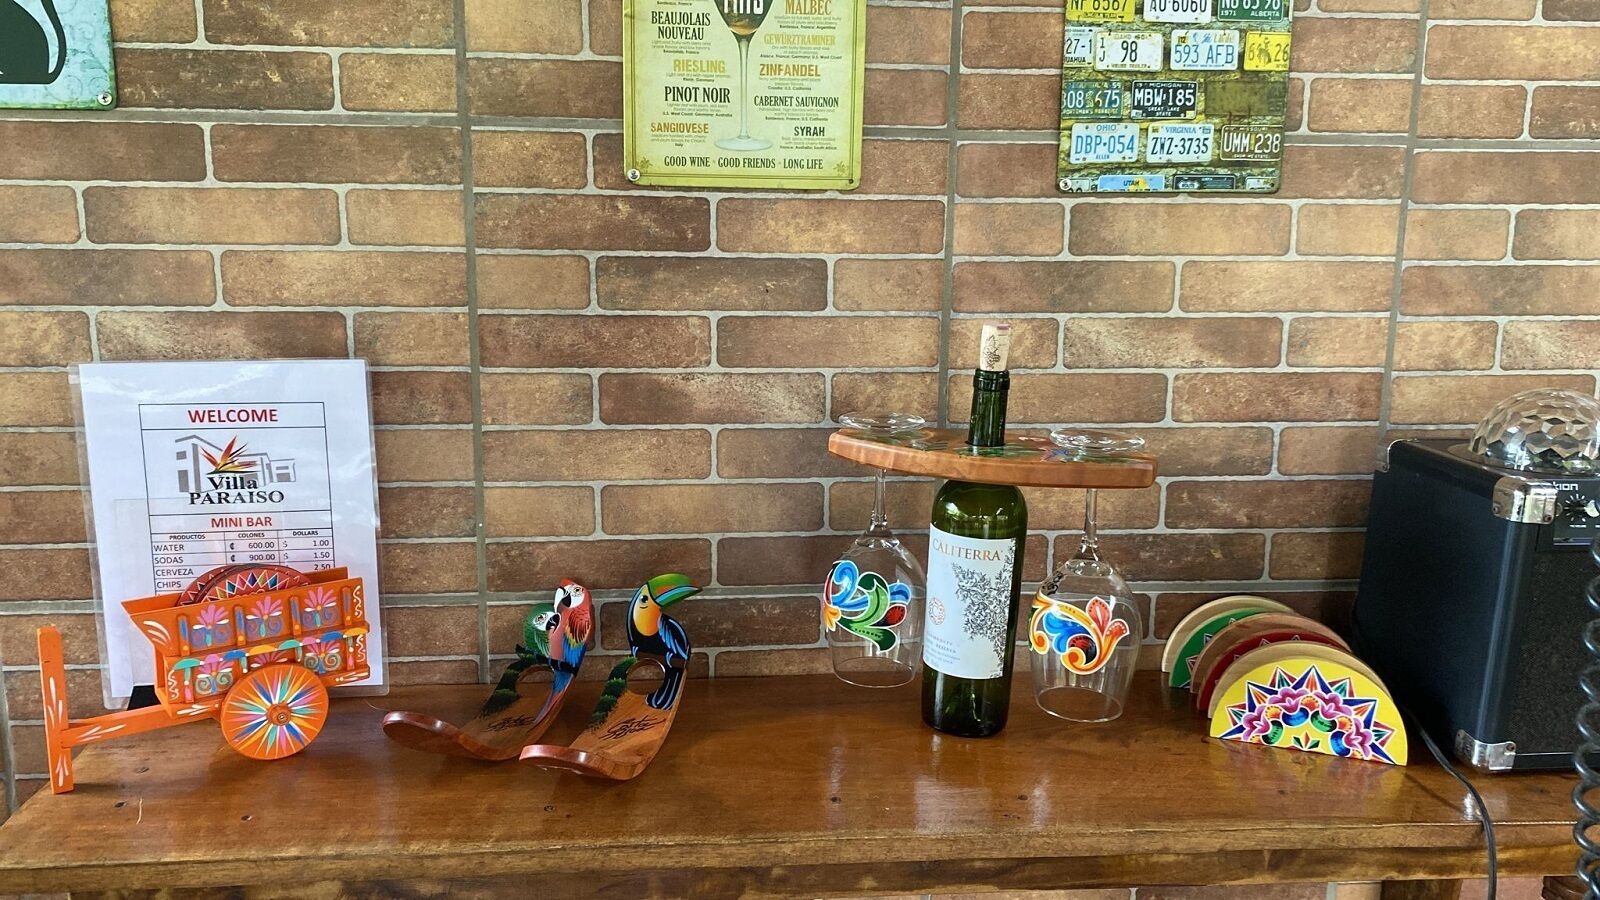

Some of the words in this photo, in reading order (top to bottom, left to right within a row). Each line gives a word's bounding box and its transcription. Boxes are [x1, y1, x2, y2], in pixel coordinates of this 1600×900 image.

[785, 0, 832, 15] MALBEC
[651, 11, 711, 26] BEAUJOLAIS
[657, 26, 704, 40] NOUVEAU
[764, 33, 836, 46] GEWÜRZTRAMINER
[1120, 40, 1138, 63] 98
[1174, 44, 1199, 63] 593
[1205, 44, 1235, 64] AFB
[673, 59, 726, 73] RIESLING
[759, 64, 821, 77] ZINFANDEL
[664, 86, 699, 103] PINOT
[702, 87, 731, 103] NOIR
[753, 95, 794, 107] CABERNET
[795, 97, 840, 108] SAUVIGNON
[650, 122, 709, 134] SANGIOVESE
[794, 126, 826, 137] SYRAH
[1165, 126, 1196, 134] VIRGINIA
[1150, 136, 1209, 156] ZWZ-3735
[1223, 132, 1251, 152] UMM
[1254, 133, 1281, 153] 238
[664, 156, 687, 167] GOOD
[689, 157, 710, 168] WINE
[718, 157, 741, 168] GOOD
[742, 158, 776, 169] FRIENDS
[783, 158, 805, 169] LONG
[806, 159, 824, 170] LIFE
[188, 409, 278, 423] WELCOME
[207, 476, 258, 490] Villa
[188, 490, 285, 505] PARAISO
[211, 518, 243, 528] MINI
[246, 516, 273, 527] BAR
[153, 544, 185, 552] WATER
[248, 541, 275, 549] 600.00
[313, 539, 330, 547] 1.00
[932, 538, 1001, 561] CALITERRA
[154, 556, 184, 565] SODAS
[249, 554, 276, 562] 900.00
[155, 568, 194, 577] CERVEZA
[313, 563, 331, 571] 250
[156, 581, 182, 589] CHIPS
